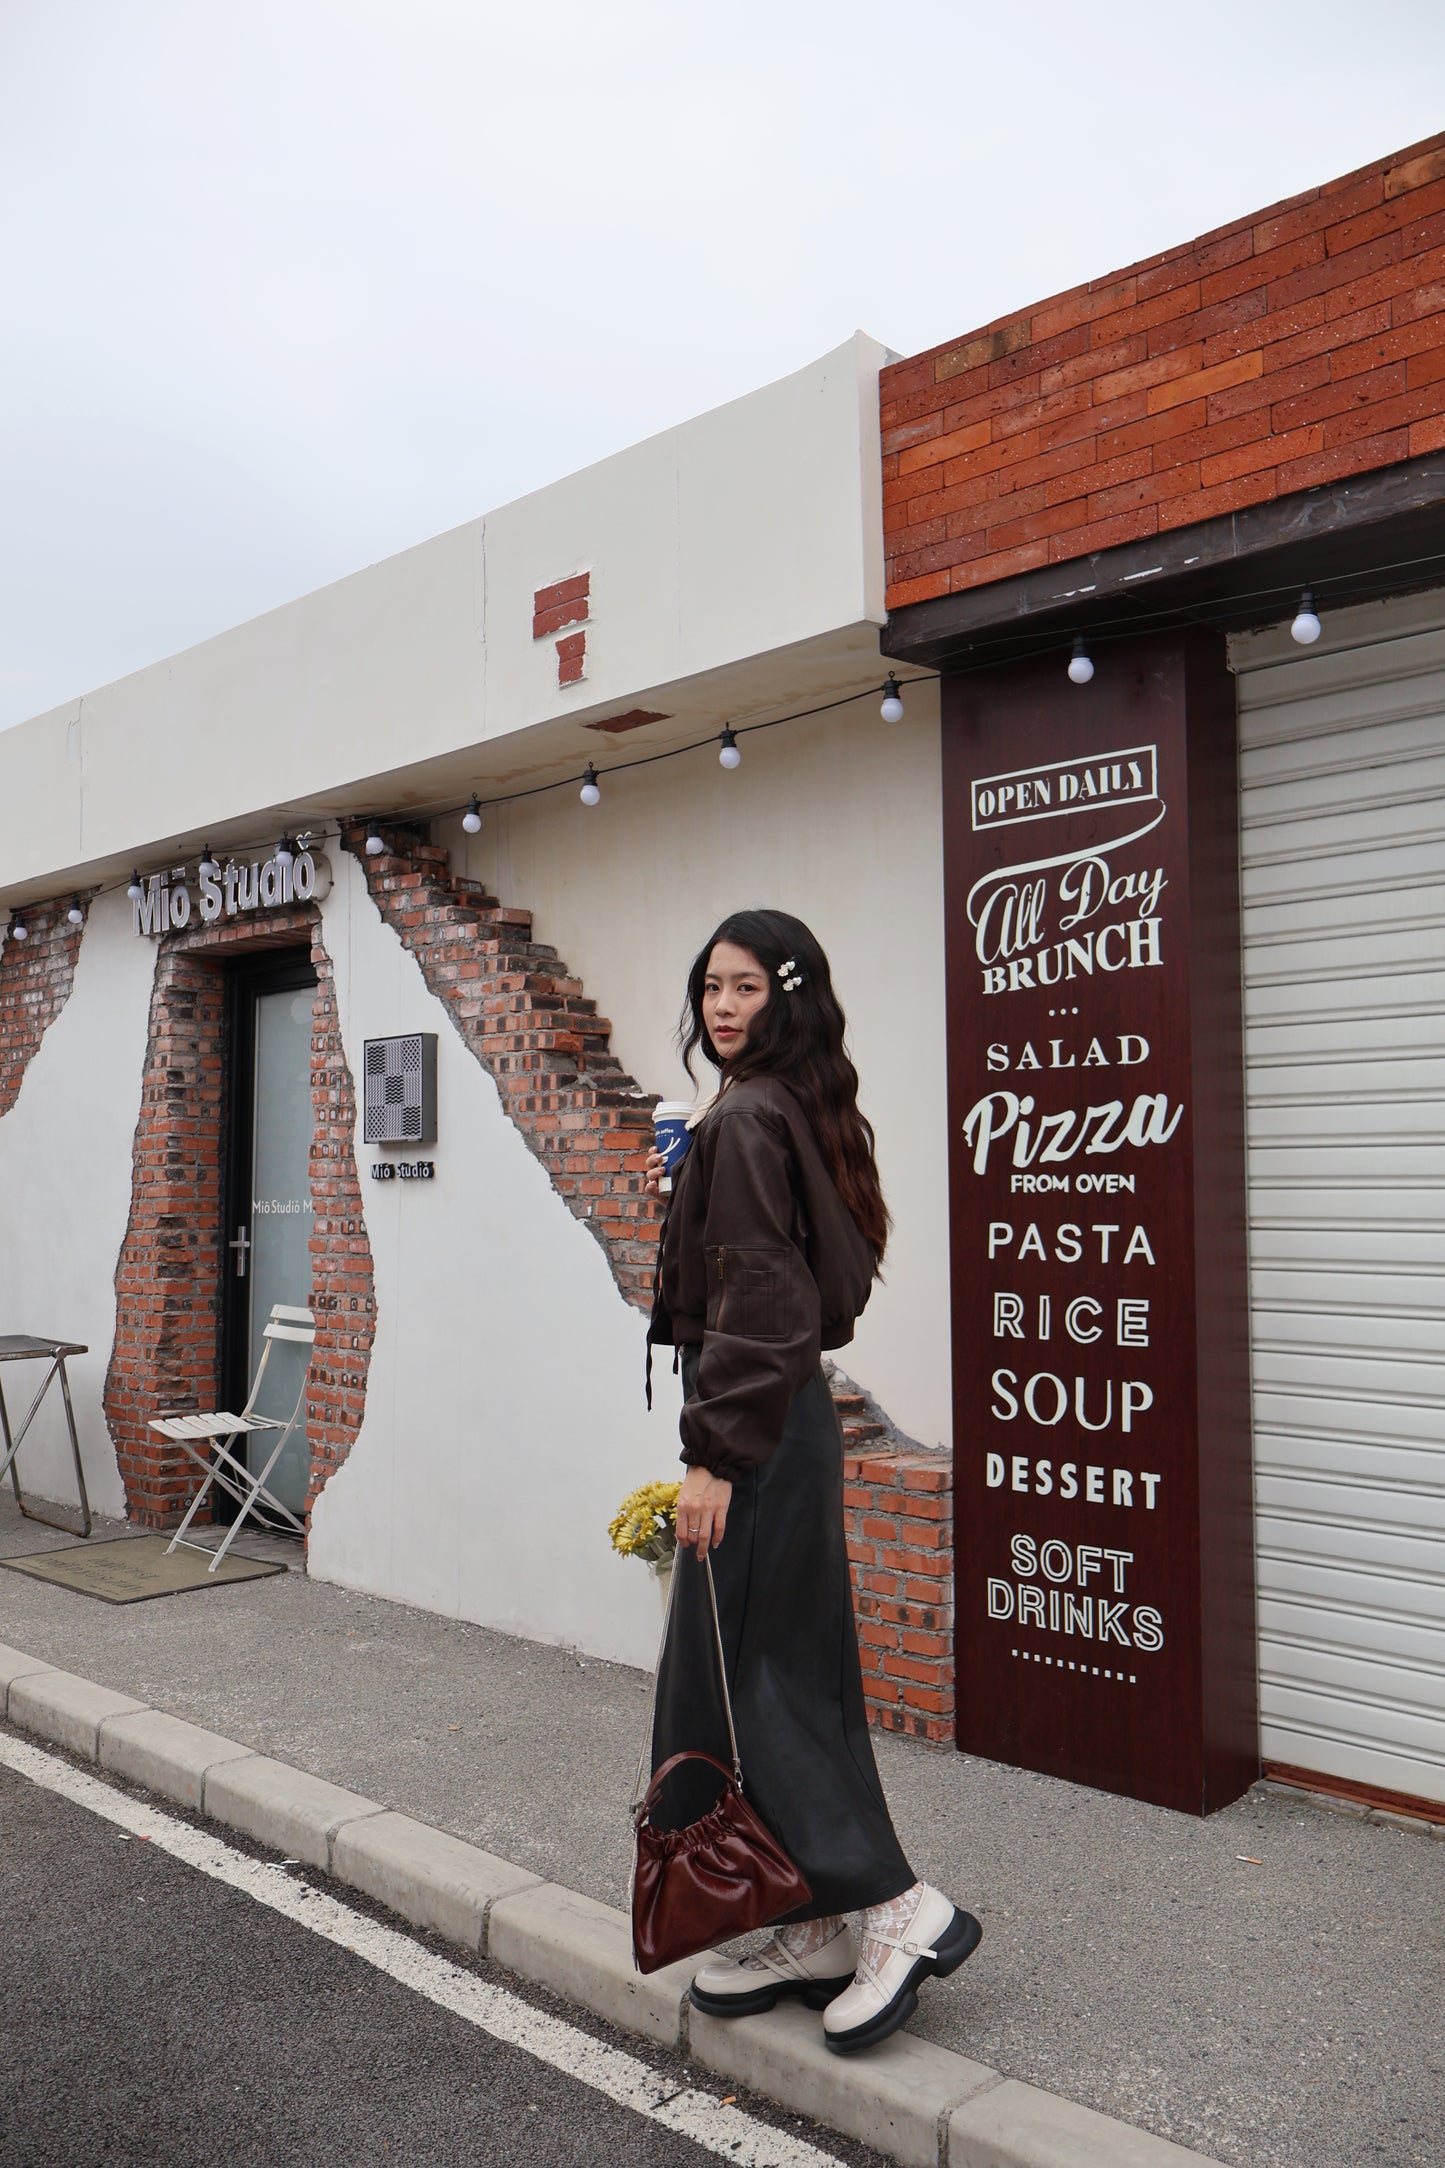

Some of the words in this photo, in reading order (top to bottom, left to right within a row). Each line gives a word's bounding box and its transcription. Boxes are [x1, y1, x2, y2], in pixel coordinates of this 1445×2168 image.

[978, 779, 1051, 817] OPEN
[1059, 760, 1144, 802] DAILY
[974, 877, 1046, 966] All
[1058, 855, 1169, 931] Day
[981, 917, 1164, 995] BRUNCH
[986, 1034, 1150, 1072] SALAD
[963, 1091, 1184, 1176] Pizza
[1010, 1174, 1070, 1193] FROM
[1076, 1173, 1135, 1194] OVEN
[988, 1222, 1156, 1266] PASTA
[993, 1292, 1150, 1347] RICE
[991, 1368, 1154, 1433] SOUP
[986, 1452, 1161, 1510] DESSERT
[1010, 1533, 1134, 1594] SOFT
[987, 1577, 1164, 1652] DRINKS
